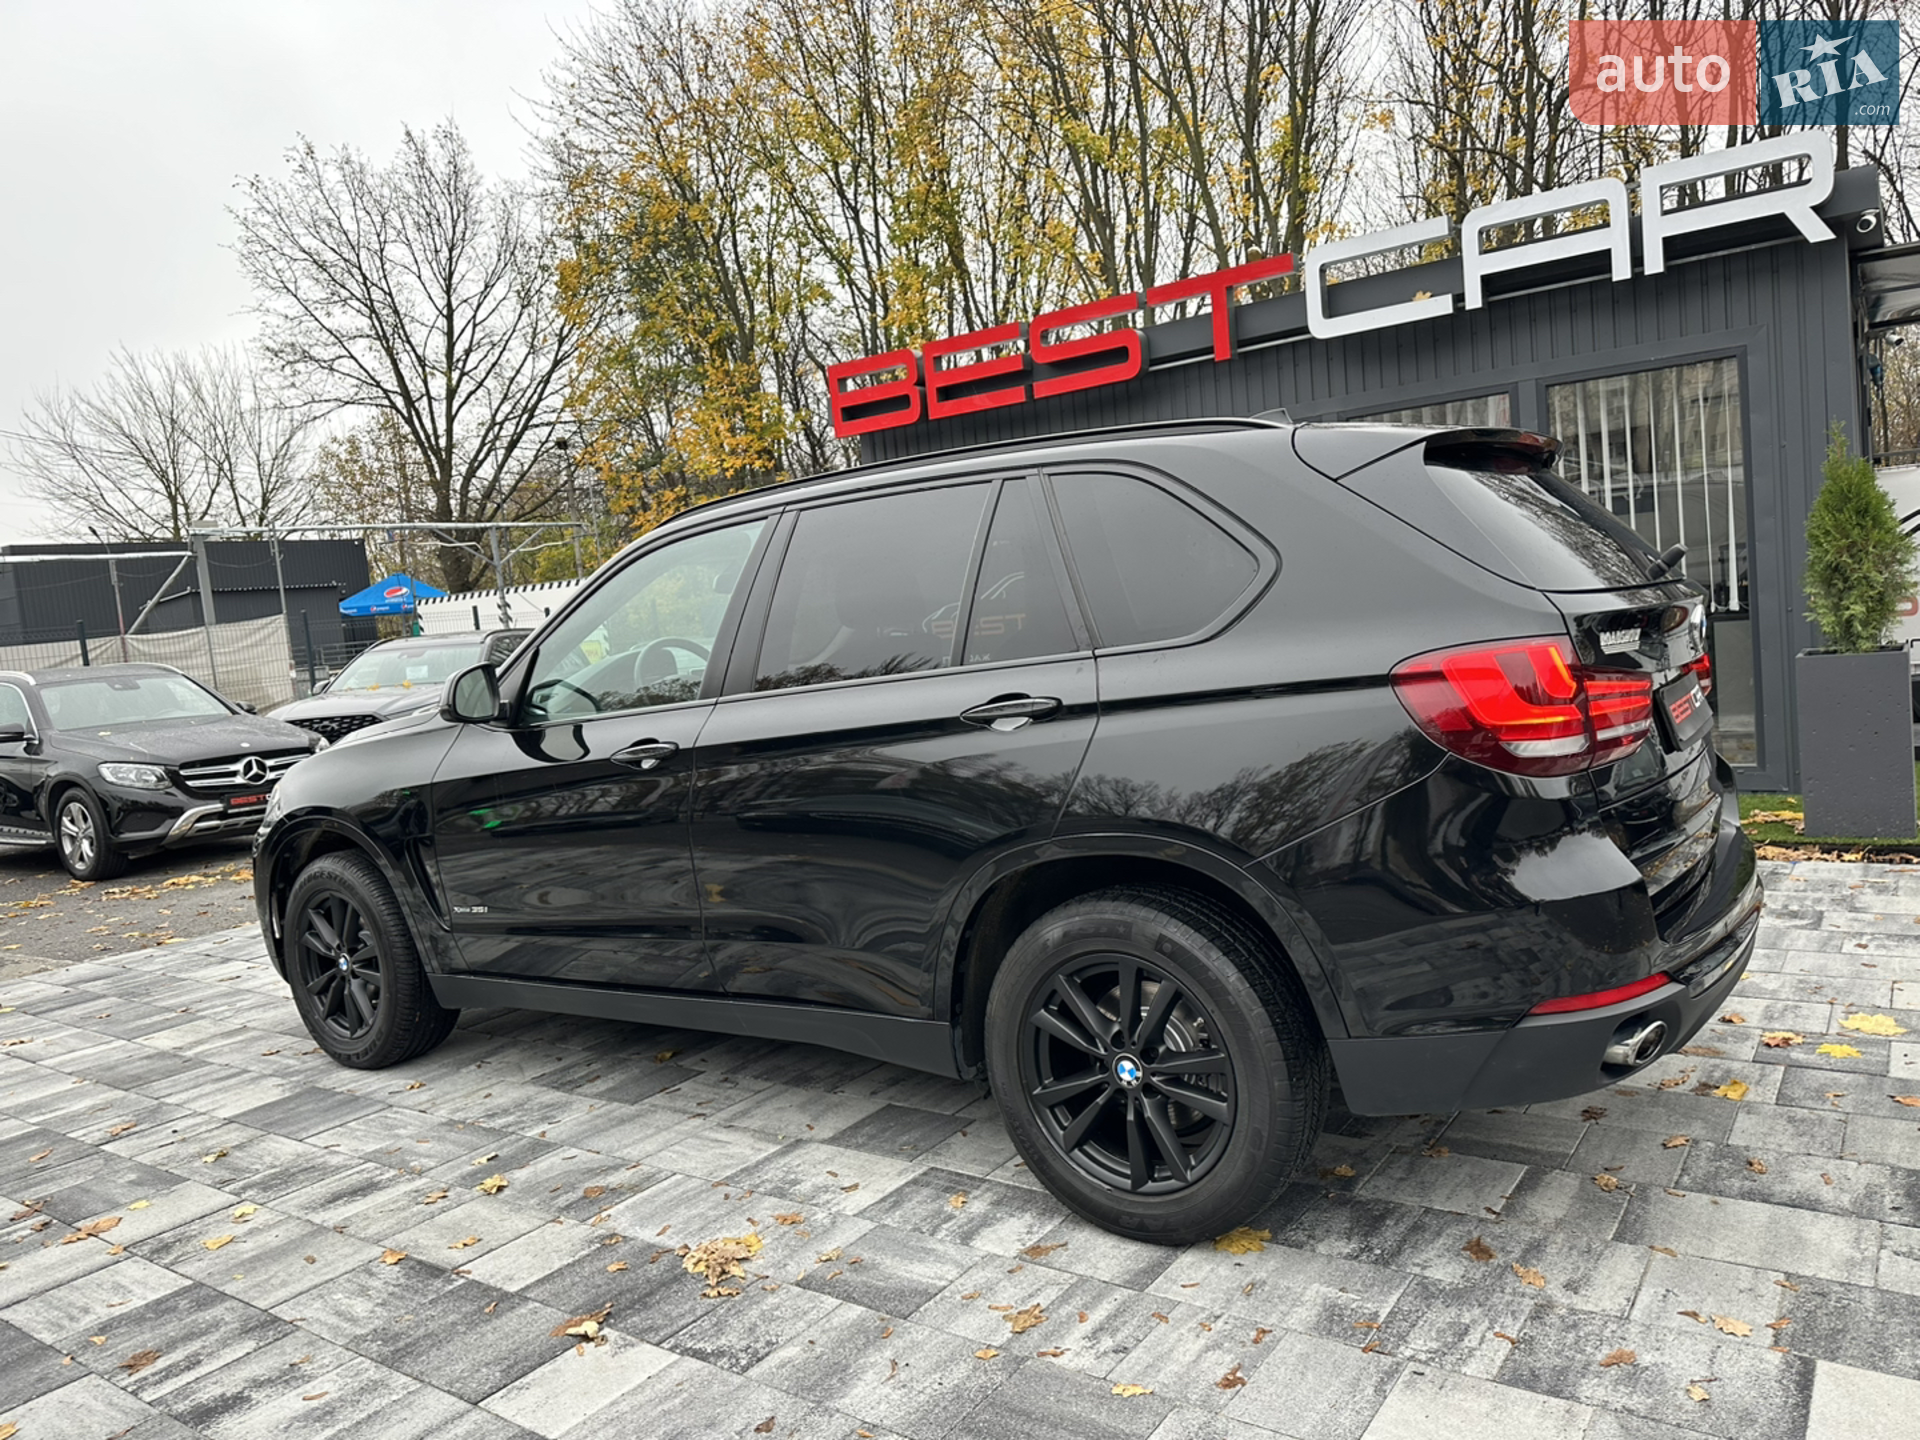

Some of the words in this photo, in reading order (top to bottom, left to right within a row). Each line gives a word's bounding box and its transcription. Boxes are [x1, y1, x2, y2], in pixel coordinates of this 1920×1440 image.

[828, 253, 1297, 438] BEST
[1306, 129, 1835, 339] CAR
[931, 613, 1026, 639] BST
